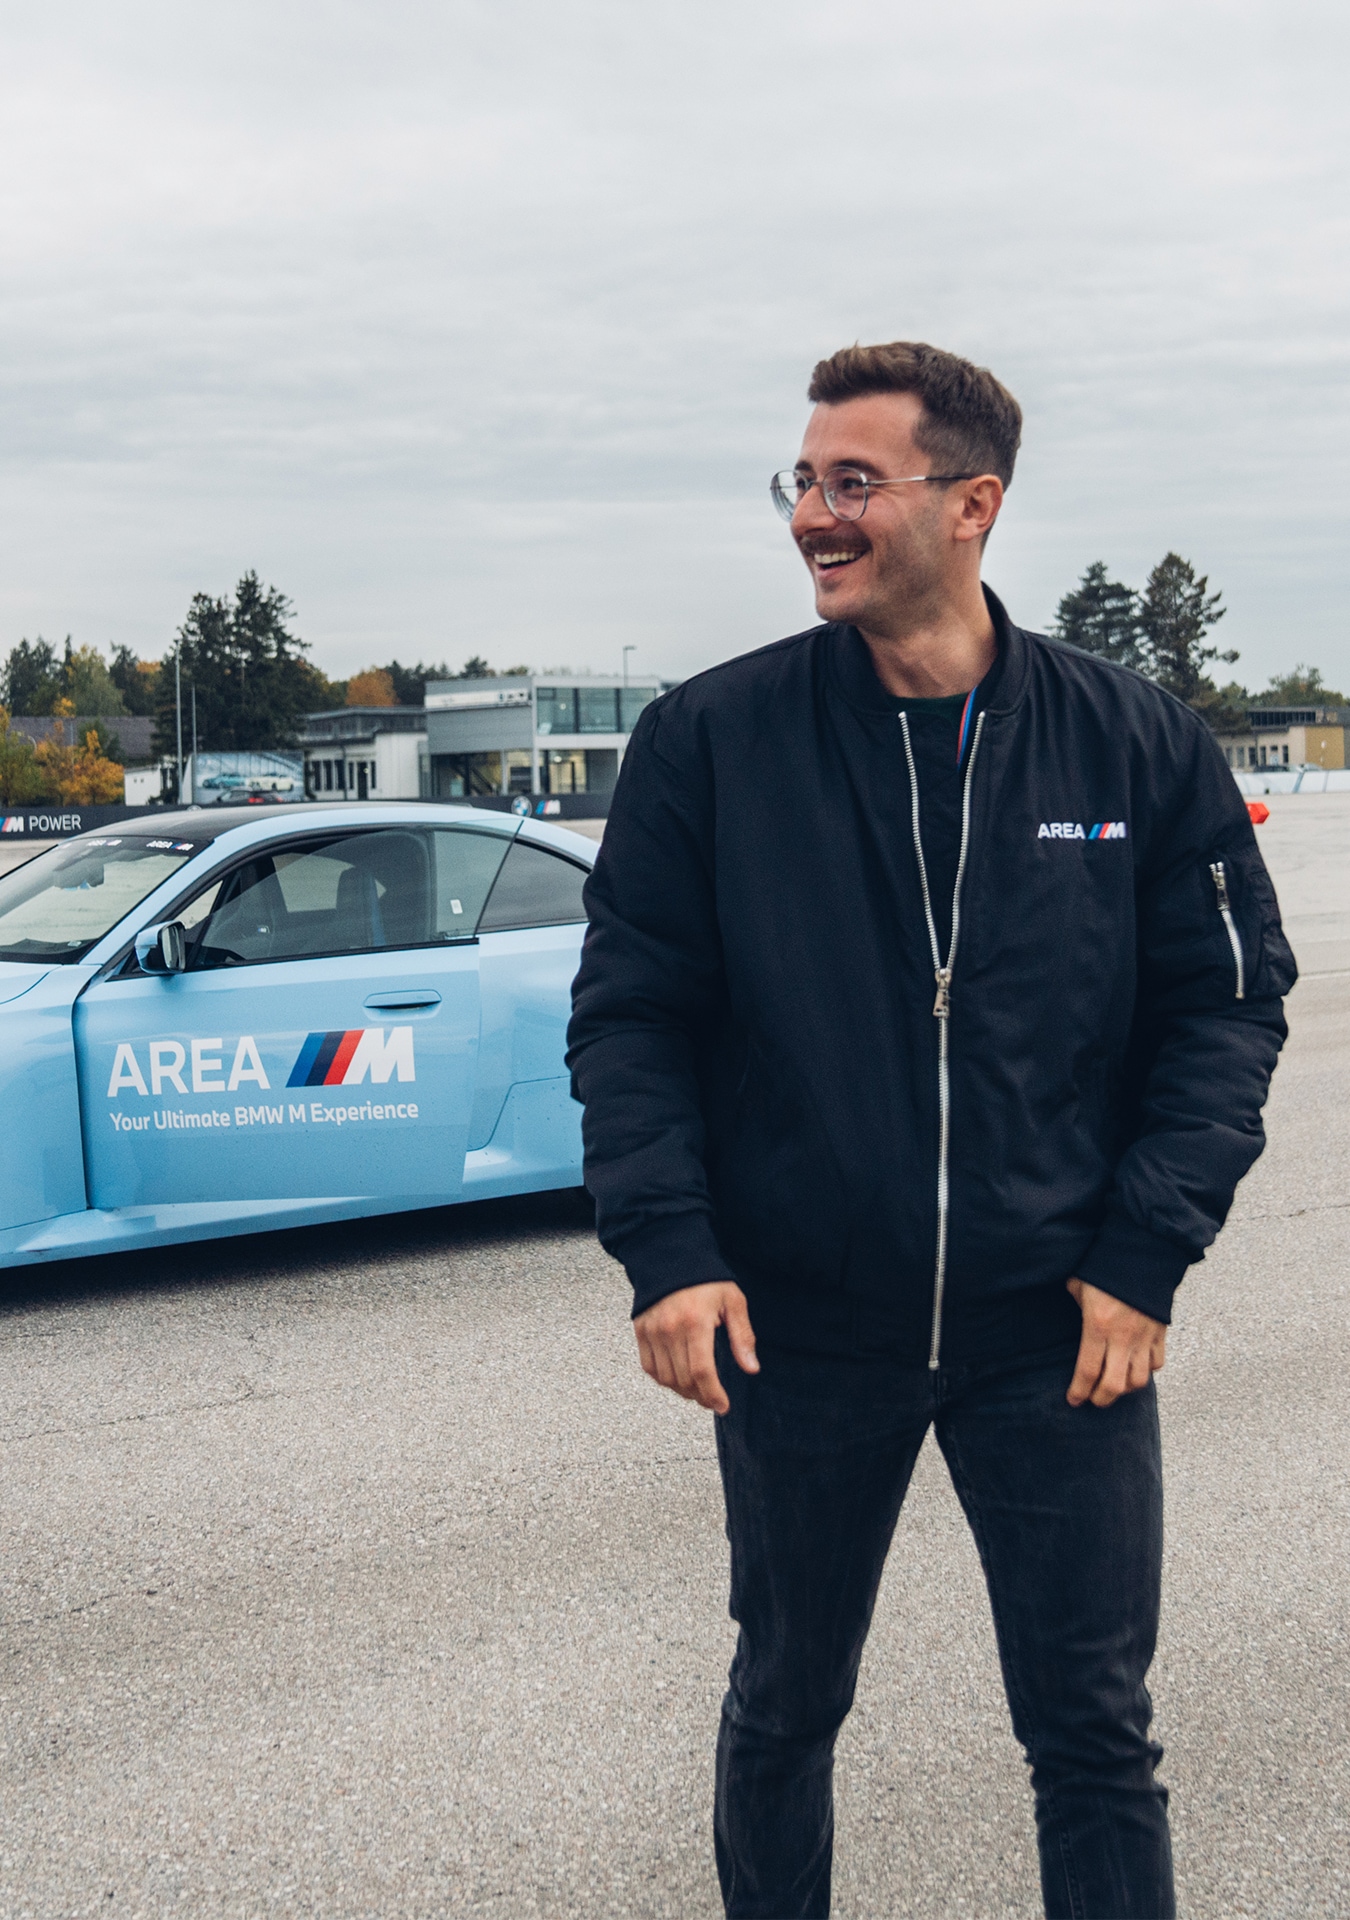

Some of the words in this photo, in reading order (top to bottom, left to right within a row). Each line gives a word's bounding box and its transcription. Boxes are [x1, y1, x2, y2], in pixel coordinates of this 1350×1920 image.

[6, 816, 25, 832] M
[29, 814, 82, 832] POWER
[1037, 822, 1086, 840] AREA
[107, 1036, 271, 1098] AREA
[341, 1025, 416, 1085] M
[109, 1112, 151, 1131] Your
[153, 1109, 231, 1130] Ultimate
[234, 1104, 284, 1126] BMW
[288, 1103, 307, 1124] M
[310, 1100, 419, 1126] Experience
